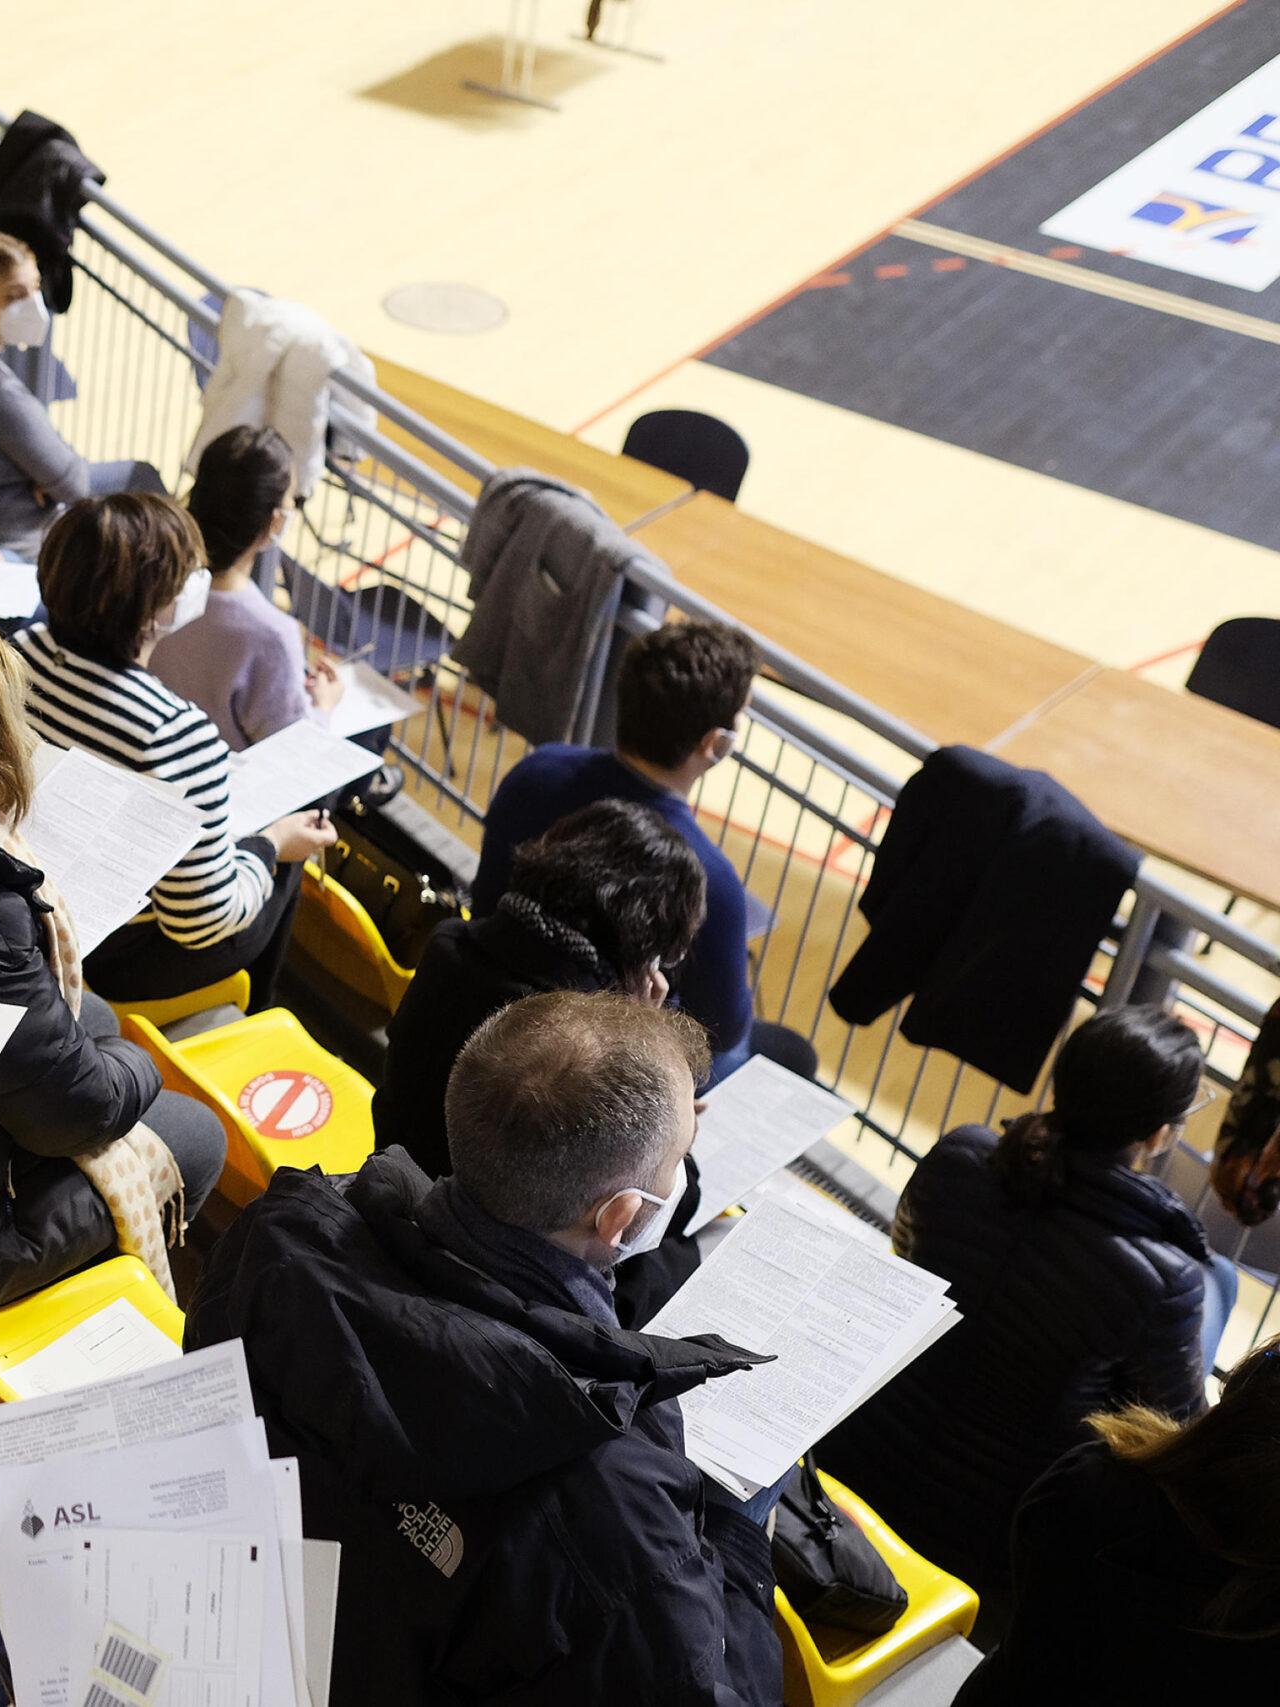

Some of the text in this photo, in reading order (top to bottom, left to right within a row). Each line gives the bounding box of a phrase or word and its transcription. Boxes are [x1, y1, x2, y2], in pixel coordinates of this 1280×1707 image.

[54, 1502, 101, 1527] ASL
[424, 1501, 453, 1533] THE
[397, 1518, 436, 1558] FACE
